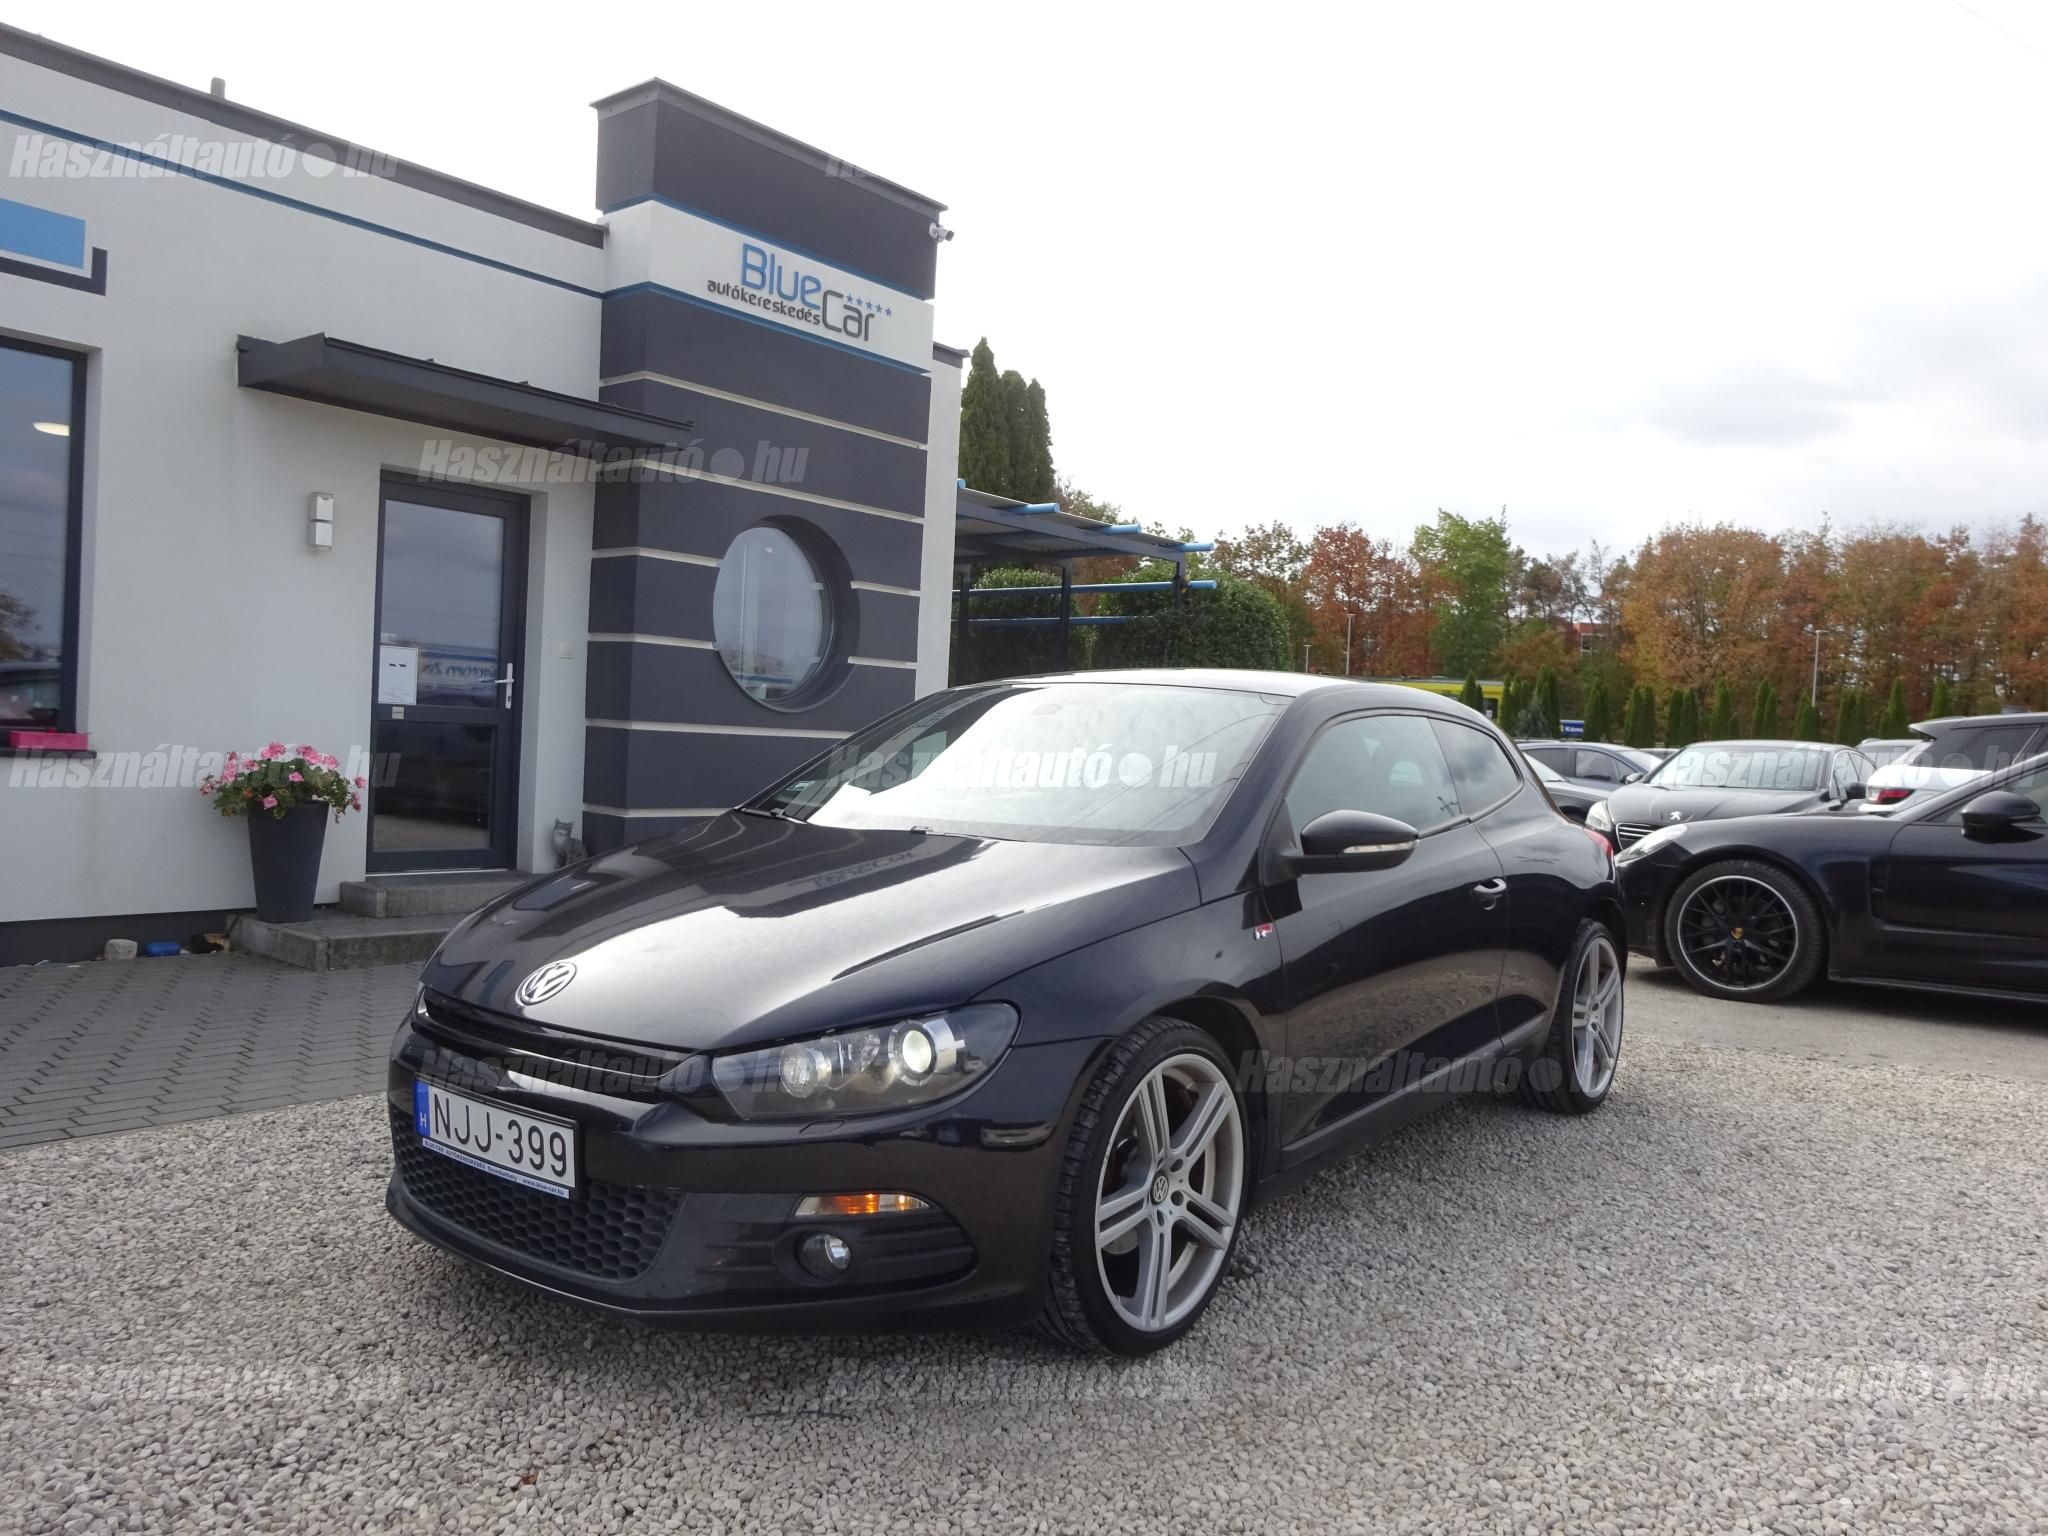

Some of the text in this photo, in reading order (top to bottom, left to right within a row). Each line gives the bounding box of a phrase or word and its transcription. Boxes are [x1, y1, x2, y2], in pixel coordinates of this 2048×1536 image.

[707, 279, 821, 326] autókereskedés
[420, 1093, 567, 1178] H NJJ-399
